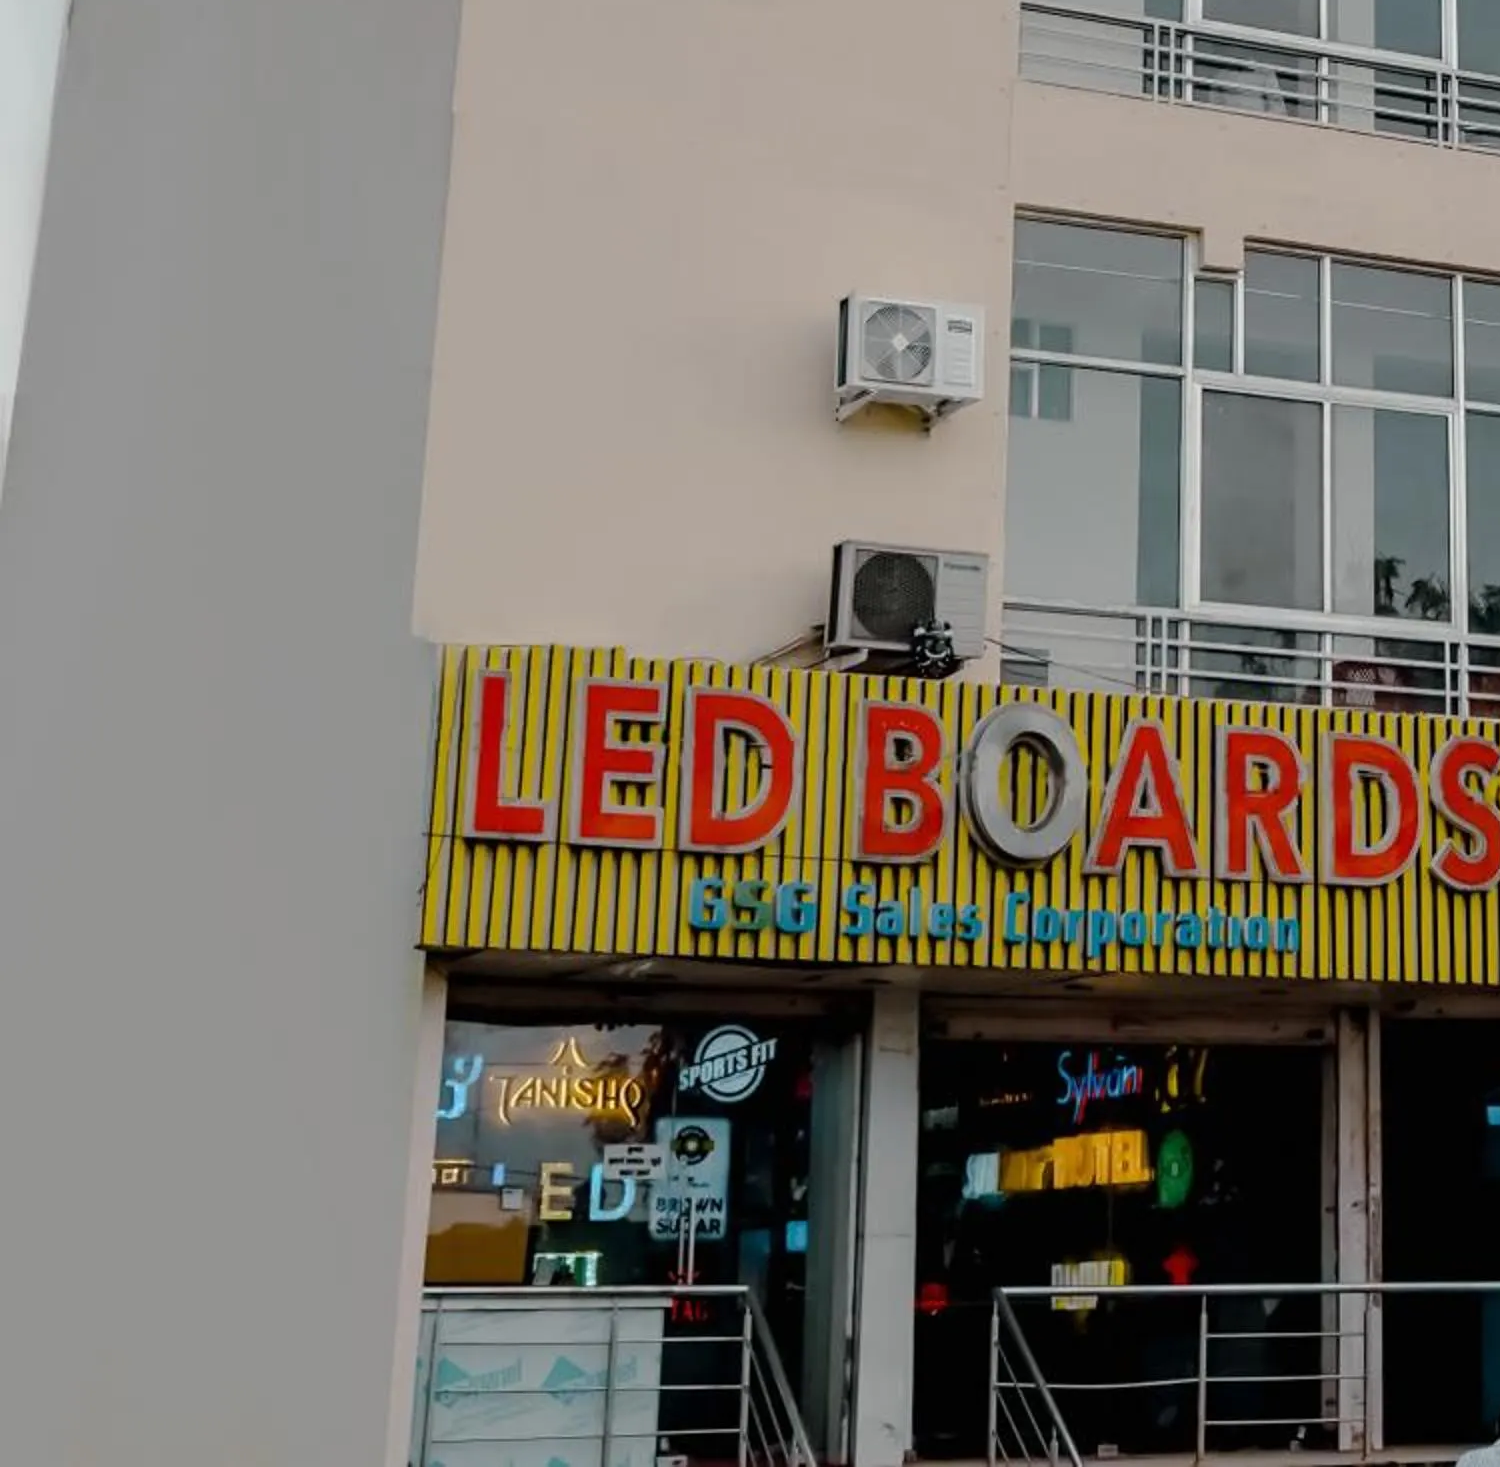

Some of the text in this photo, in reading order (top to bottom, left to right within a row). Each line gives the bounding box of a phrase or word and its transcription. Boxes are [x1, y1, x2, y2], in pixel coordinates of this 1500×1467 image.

[463, 669, 801, 854] LED
[689, 876, 1300, 960] GSG Sales Corporation
[678, 1037, 780, 1092] SPORTS FIT
